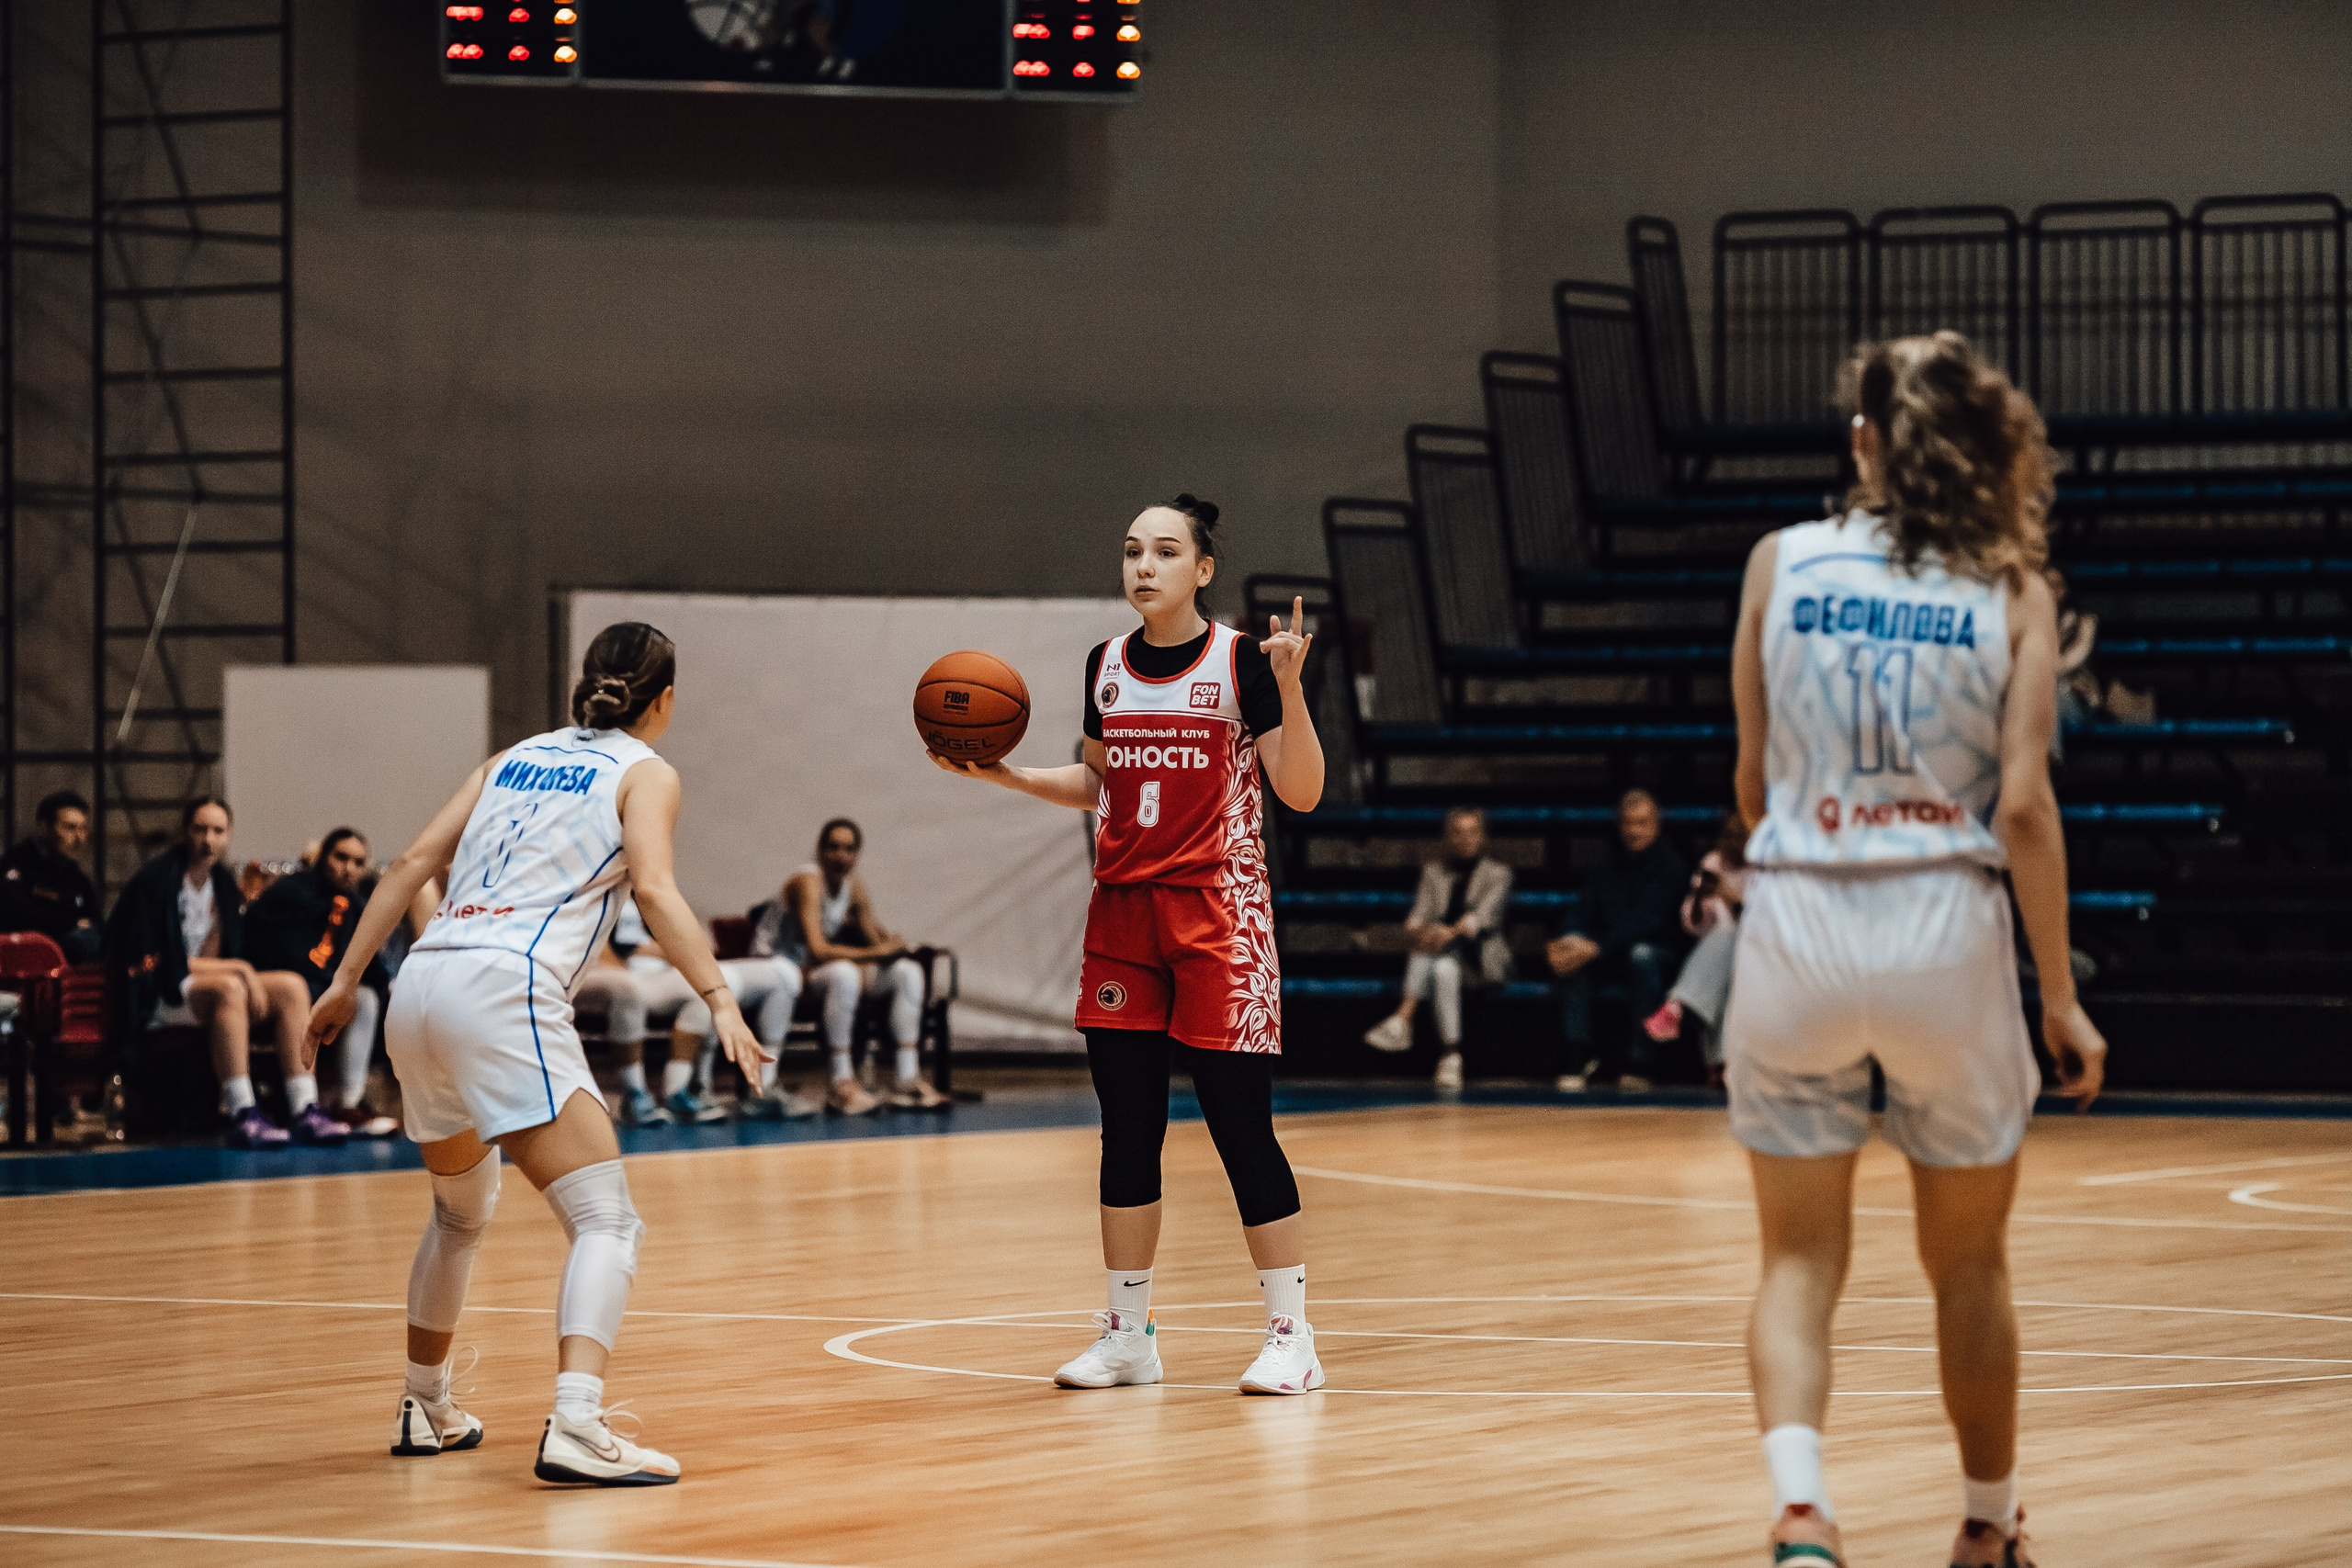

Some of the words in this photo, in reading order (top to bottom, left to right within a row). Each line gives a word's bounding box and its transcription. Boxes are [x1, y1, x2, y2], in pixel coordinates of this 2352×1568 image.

[1793, 596, 1975, 649] ФЕФИЛОВА
[1193, 685, 1218, 695] FON
[944, 691, 970, 705] FIBA
[1191, 695, 1217, 705] BET
[1847, 641, 1915, 776] 11
[1182, 729, 1210, 739] КЛУБ
[1137, 781, 1160, 828] 6
